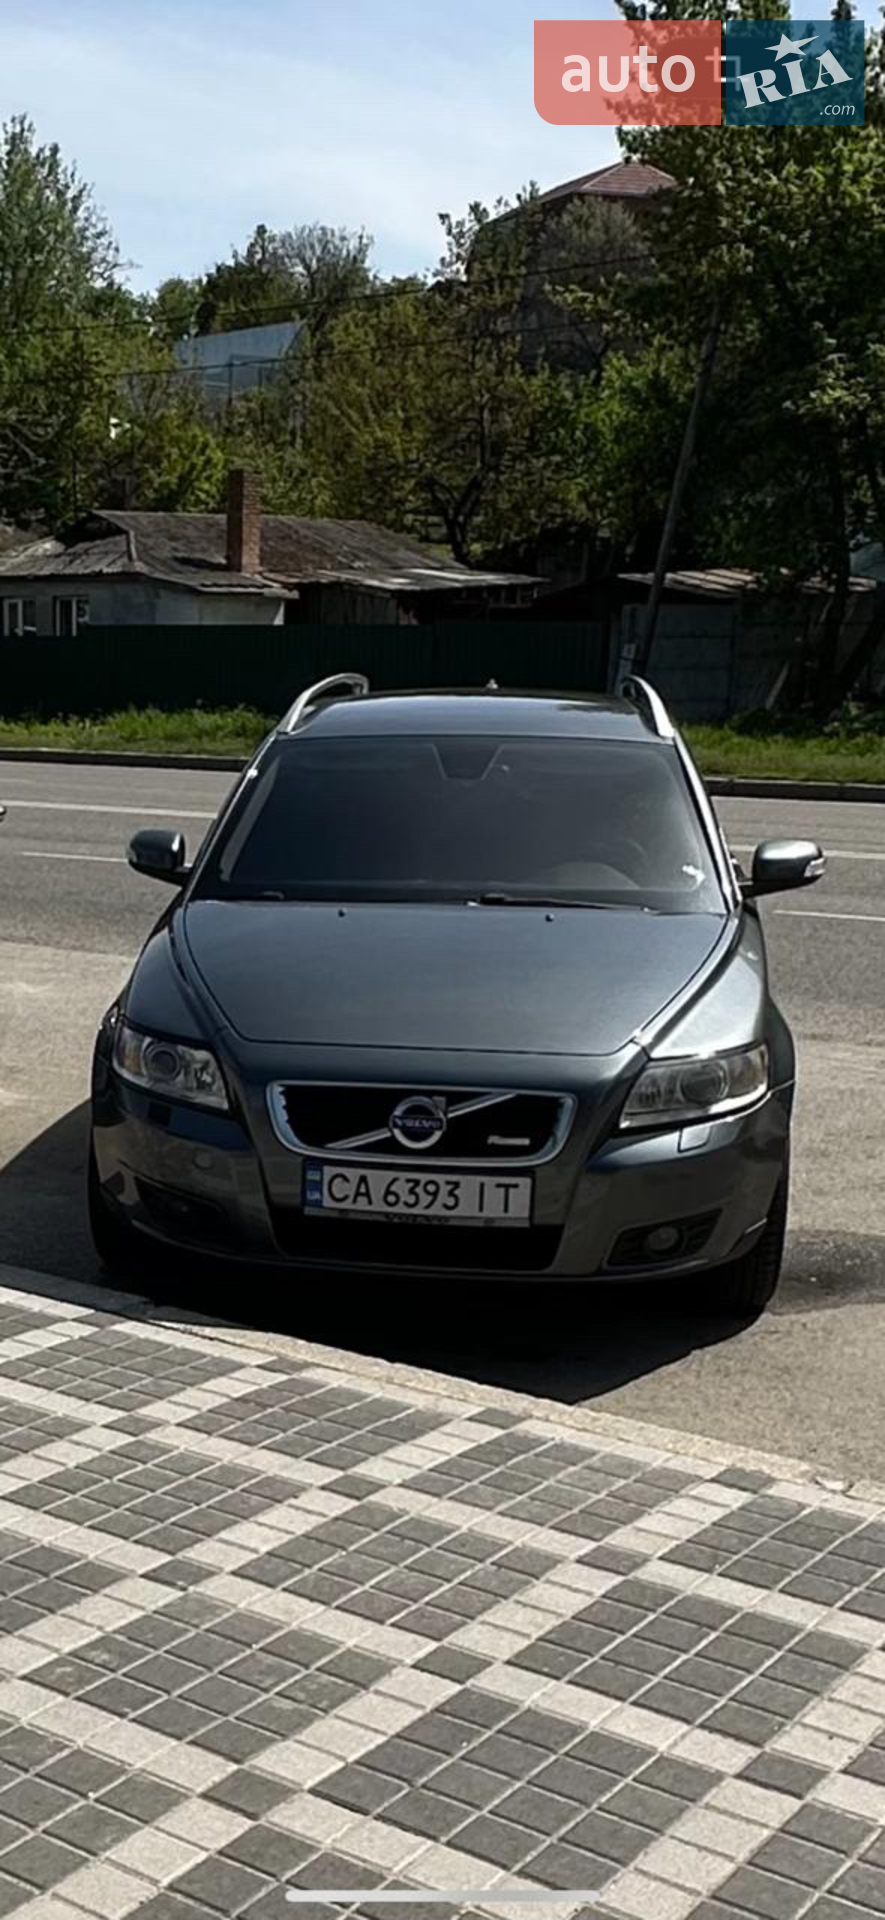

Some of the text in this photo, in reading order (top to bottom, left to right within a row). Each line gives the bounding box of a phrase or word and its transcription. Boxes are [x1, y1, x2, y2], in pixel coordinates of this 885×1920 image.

[327, 1172, 520, 1214] CA 6393 IT
